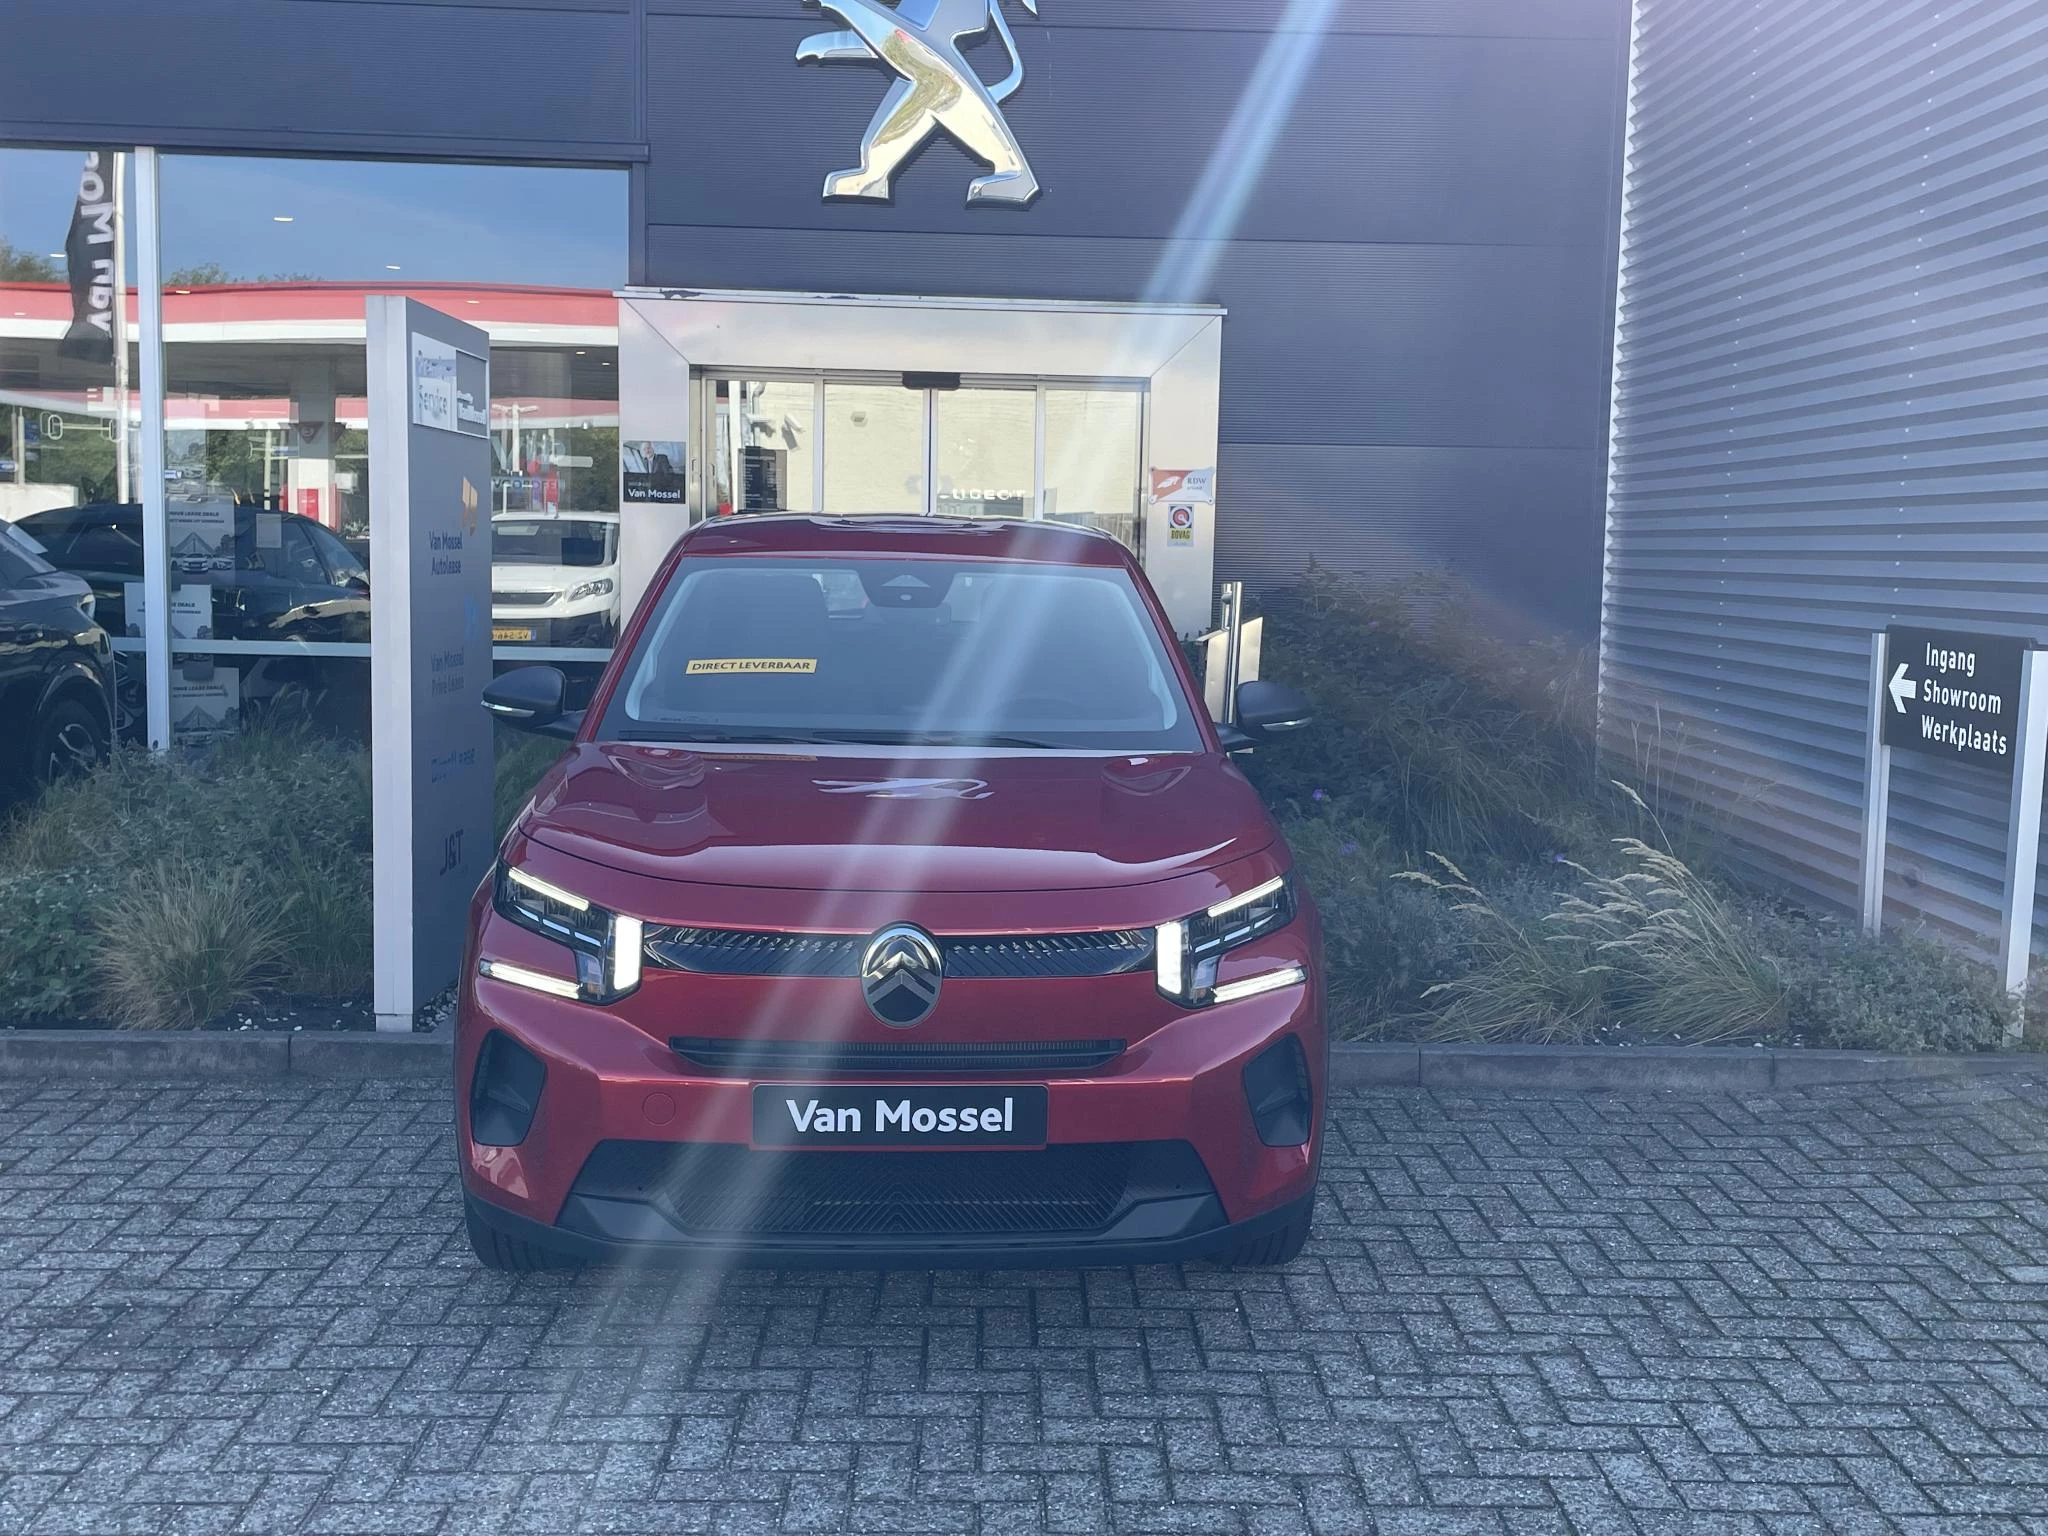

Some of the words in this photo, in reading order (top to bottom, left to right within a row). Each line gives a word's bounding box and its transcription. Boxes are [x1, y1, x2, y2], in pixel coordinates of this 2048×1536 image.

[1187, 477, 1207, 485] RDW
[628, 488, 646, 498] Van
[648, 489, 681, 499] Mossel
[429, 530, 441, 550] Van
[442, 531, 463, 550] Mossel
[1171, 529, 1191, 540] BOVAG
[431, 556, 462, 576] Autolease
[692, 662, 737, 671] DIRECT
[738, 661, 811, 670] LEVERBAAR
[1925, 642, 1976, 677] Ingang
[1923, 678, 2002, 714] Showroom
[1921, 714, 2008, 755] Werkplaats
[786, 1099, 861, 1133] Van
[875, 1097, 1013, 1133] Mossel
